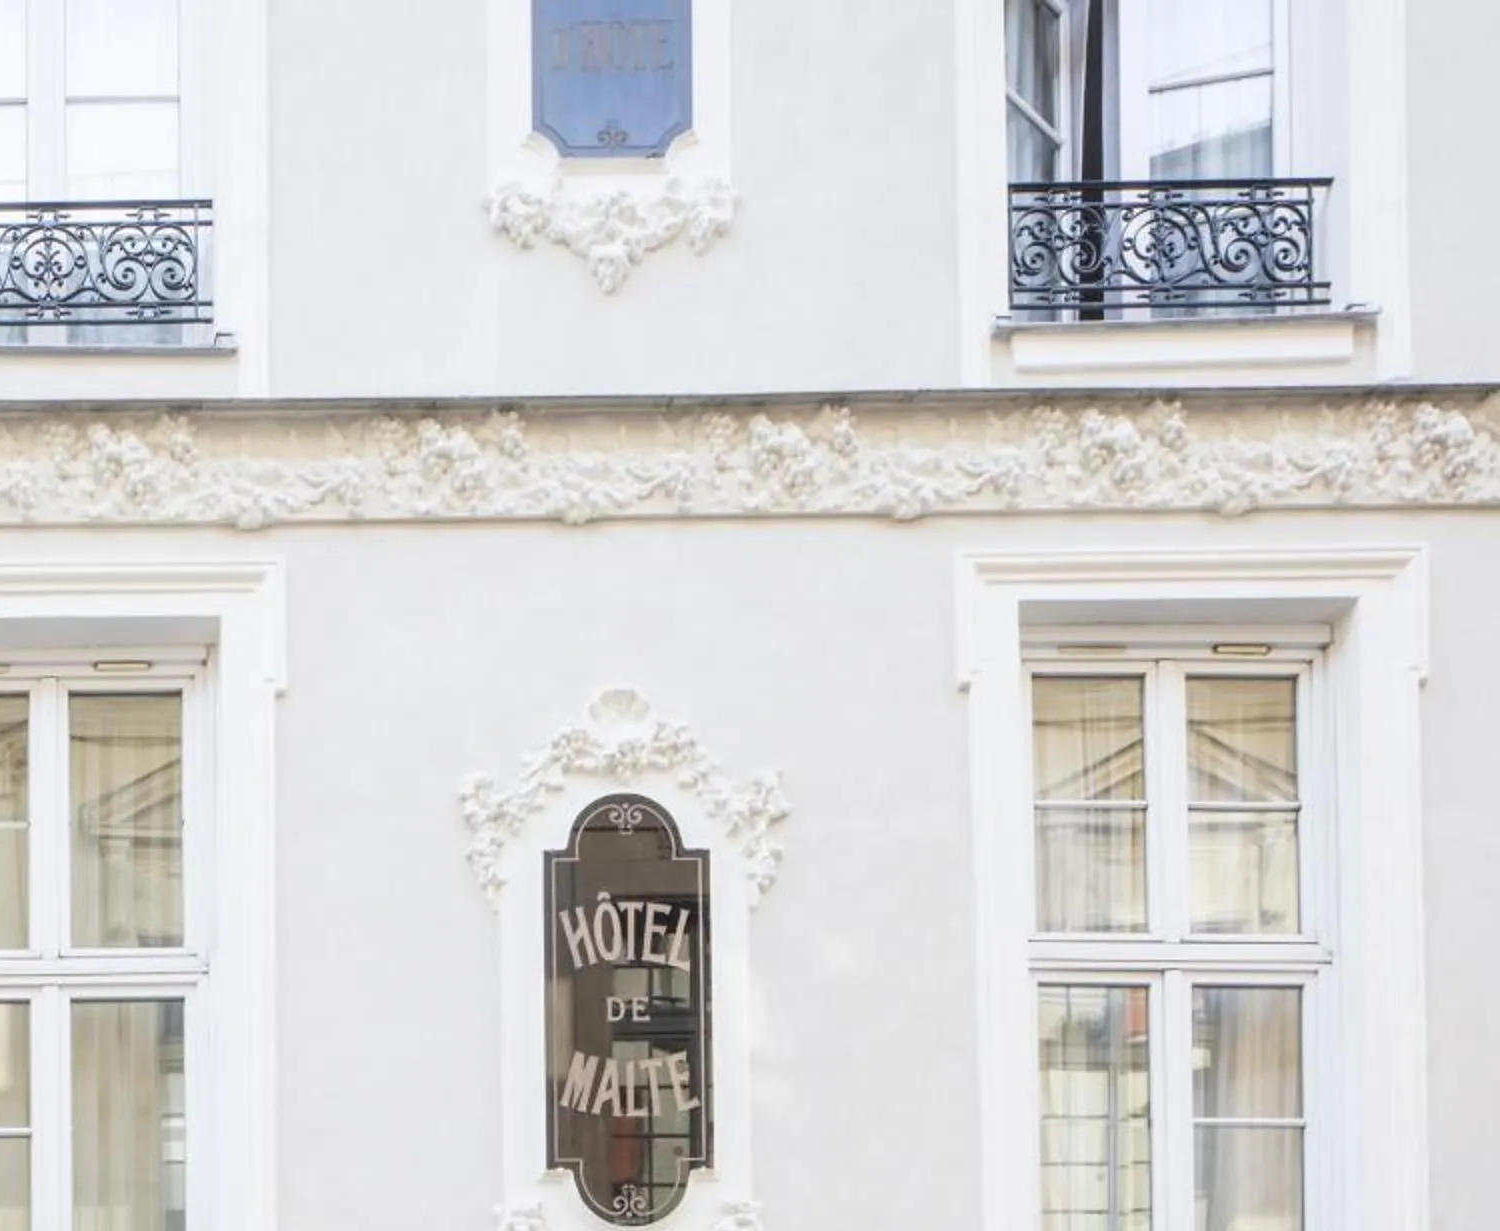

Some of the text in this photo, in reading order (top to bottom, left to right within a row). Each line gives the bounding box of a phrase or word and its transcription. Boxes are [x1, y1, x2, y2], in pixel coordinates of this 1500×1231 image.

[560, 891, 690, 972] HÔTEL
[607, 997, 650, 1022] DE
[560, 1051, 699, 1117] MALTE
